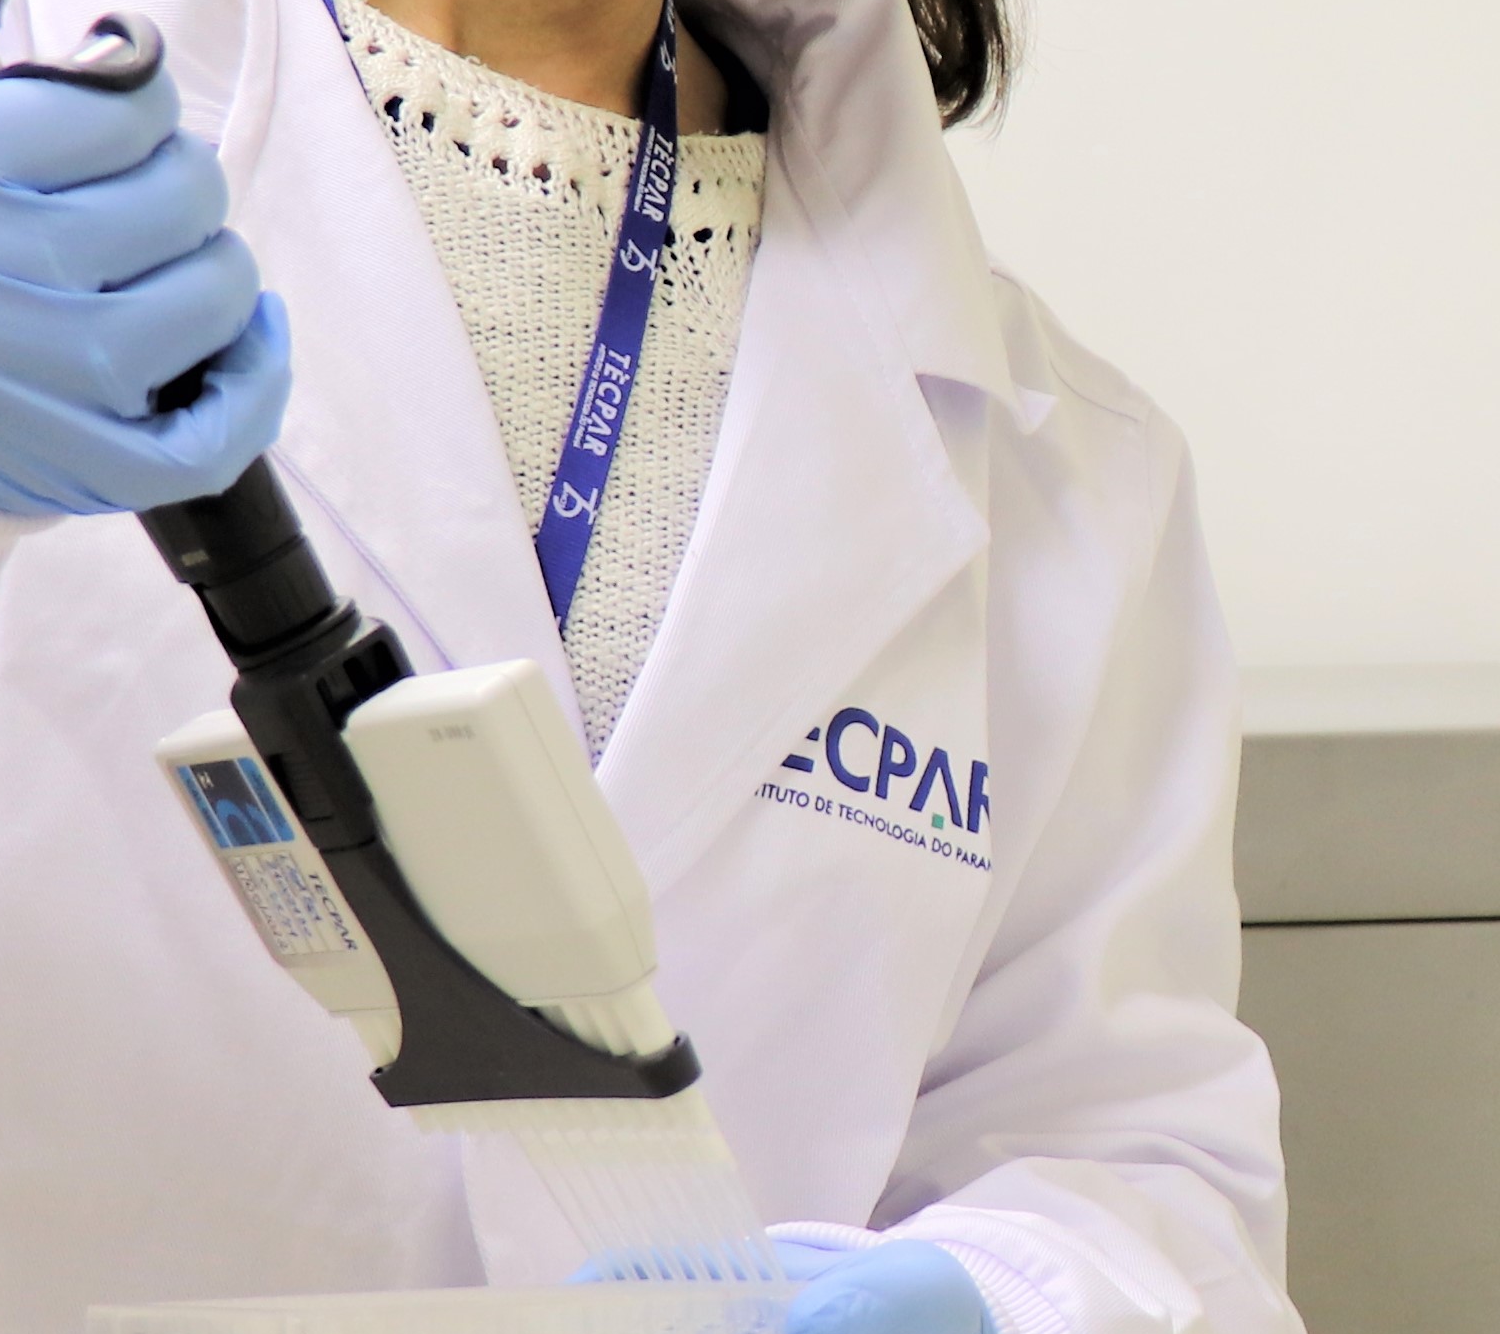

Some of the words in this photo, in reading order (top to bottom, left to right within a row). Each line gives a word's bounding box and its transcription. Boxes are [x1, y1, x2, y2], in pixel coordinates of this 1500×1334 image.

[642, 133, 675, 223] TECPAR
[582, 350, 632, 456] TECPAR
[815, 796, 833, 815] DE
[838, 803, 926, 849] TECNOLOGIA
[932, 837, 952, 857] DO
[309, 872, 359, 953] TECPAR
